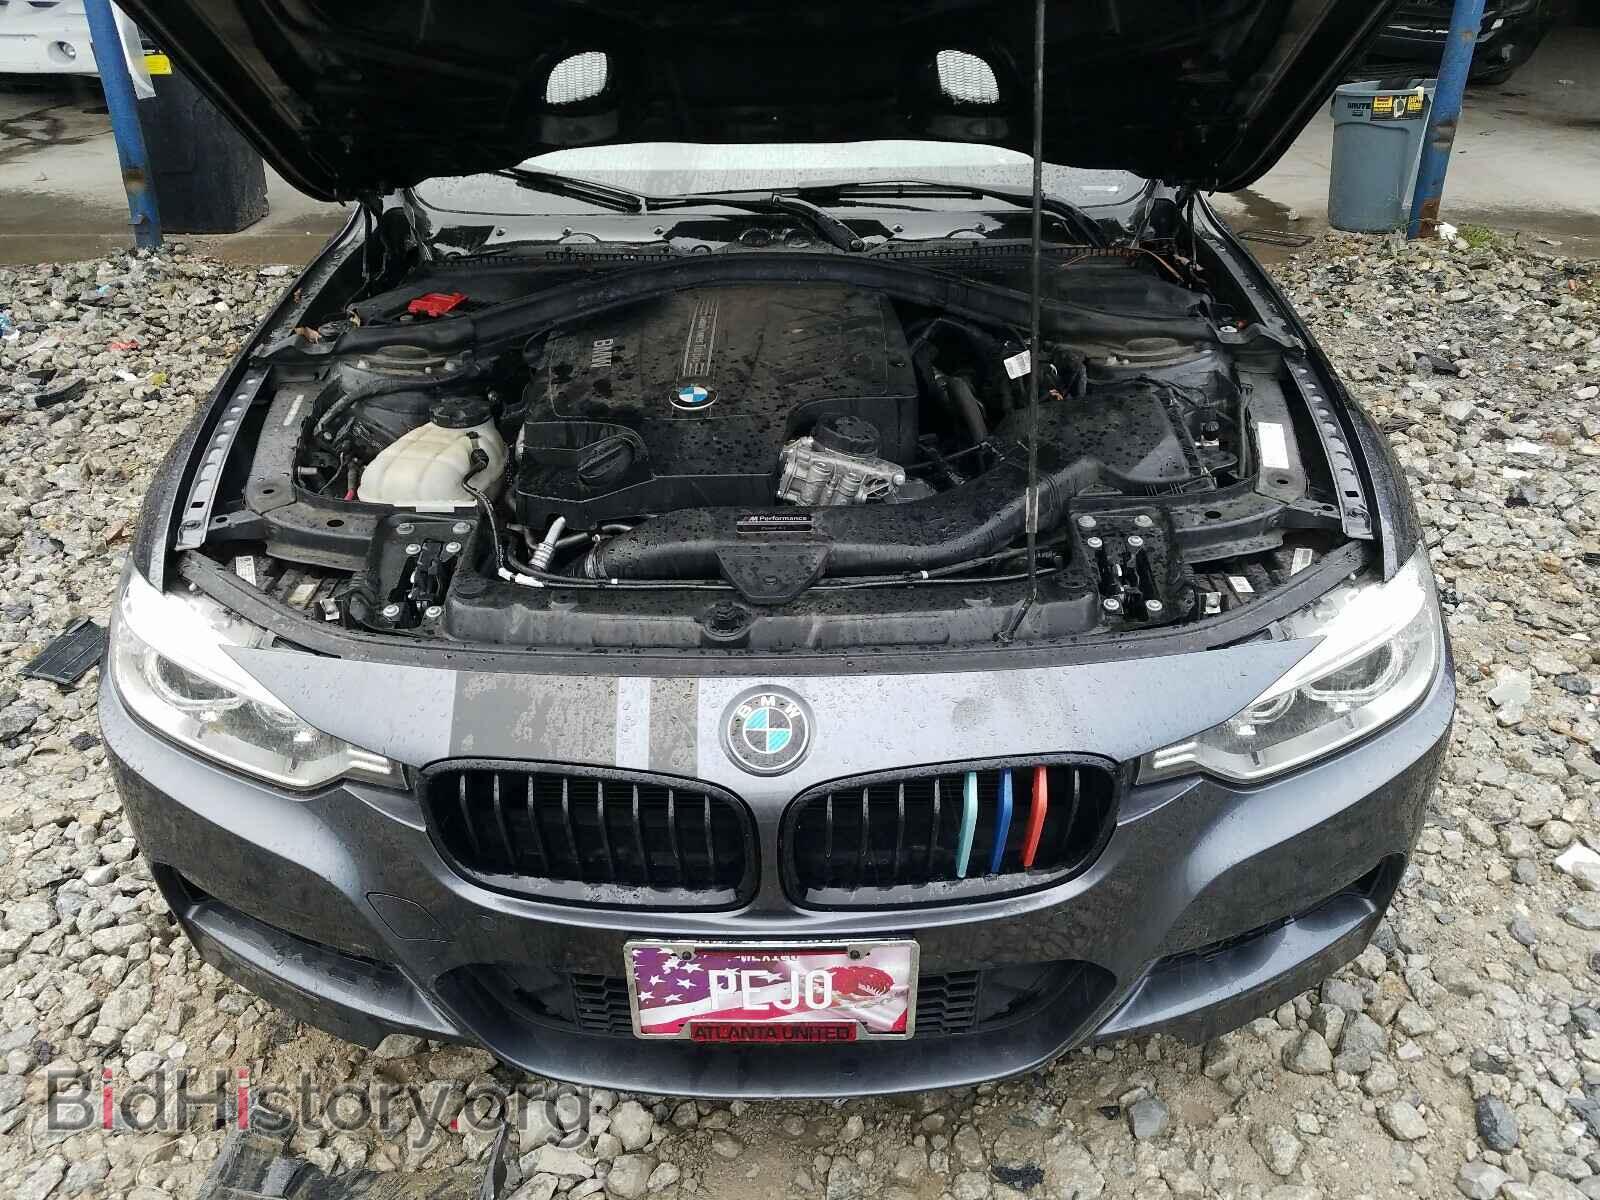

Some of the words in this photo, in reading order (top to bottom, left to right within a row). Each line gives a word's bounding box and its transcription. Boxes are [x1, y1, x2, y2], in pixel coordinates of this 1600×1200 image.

[591, 338, 614, 368] BMW
[737, 695, 800, 719] BMW
[695, 1025, 775, 1040] ATLANTA
[783, 1025, 850, 1040] UNITED
